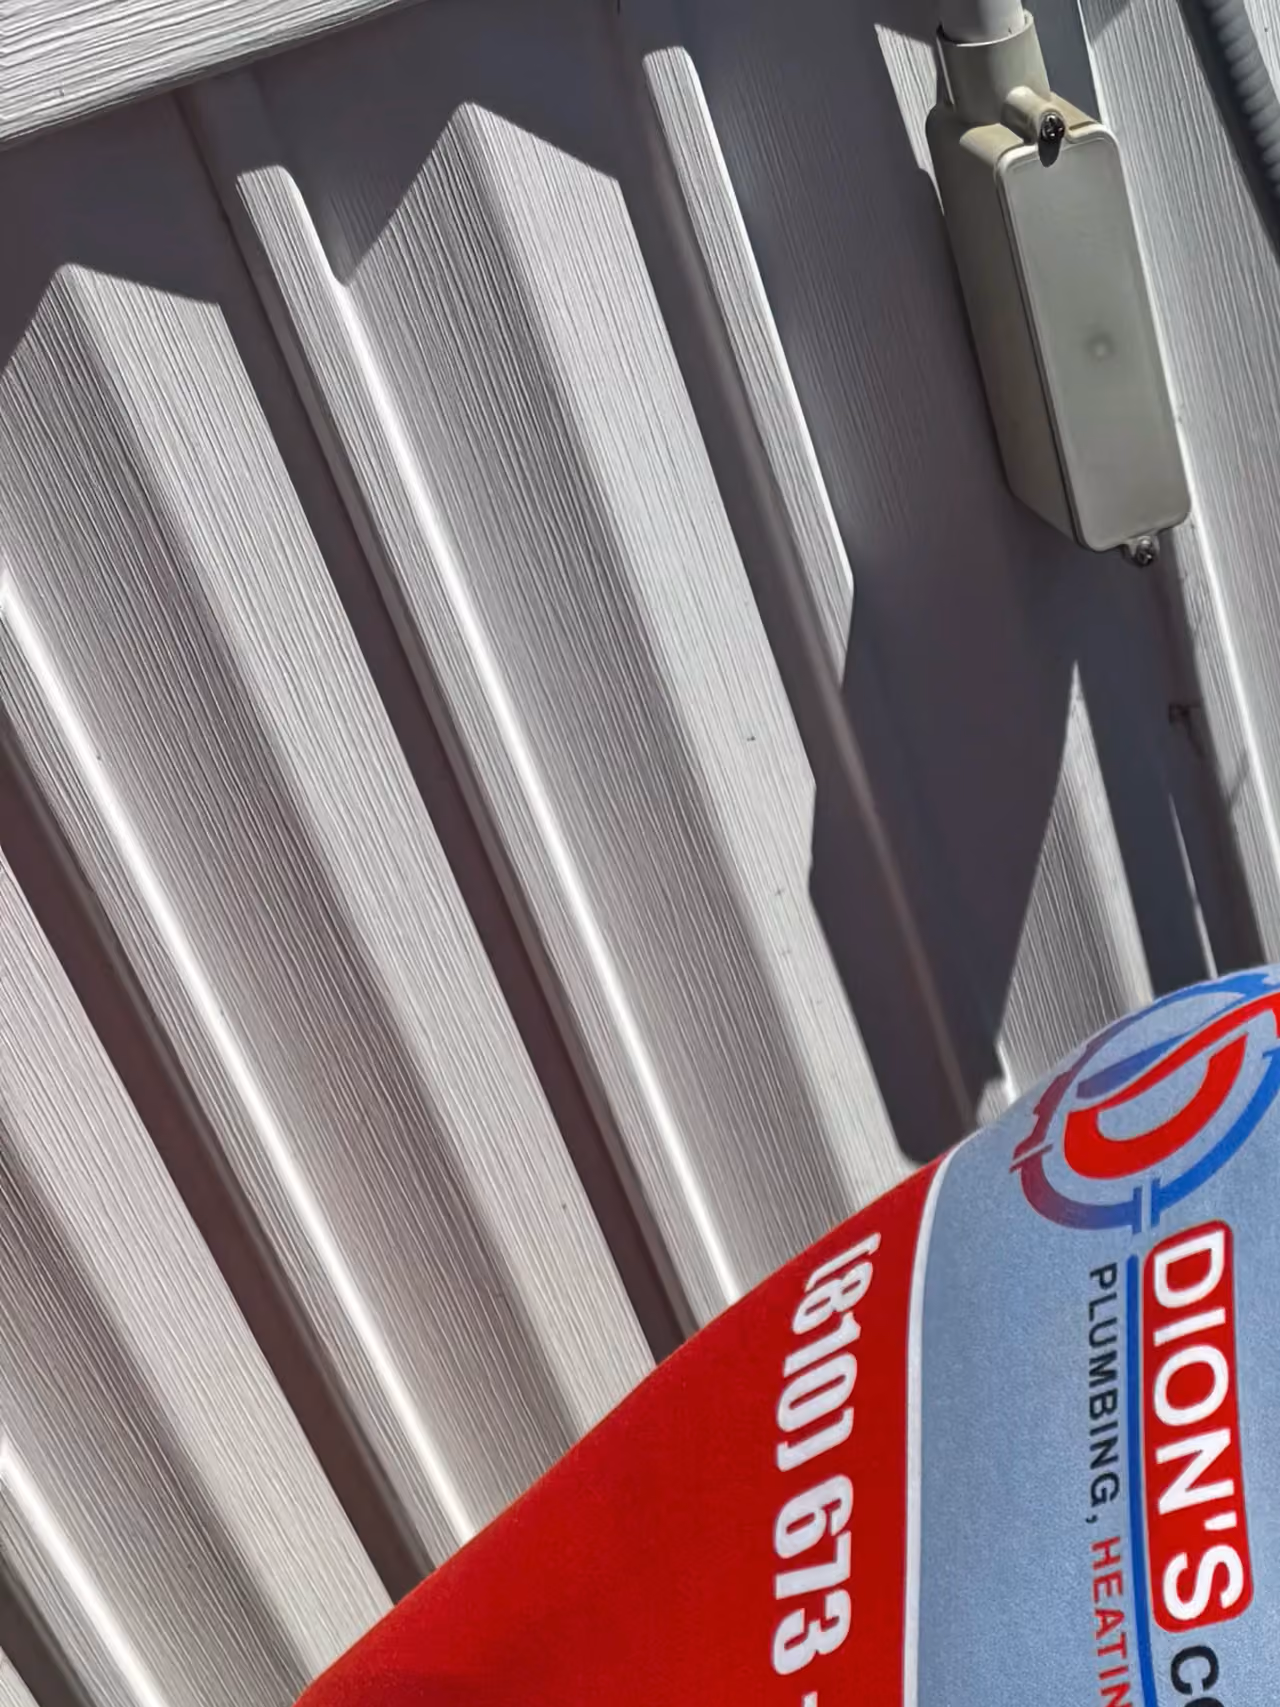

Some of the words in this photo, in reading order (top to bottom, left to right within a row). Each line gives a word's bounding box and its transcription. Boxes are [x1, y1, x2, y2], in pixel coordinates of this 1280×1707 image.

[1085, 1261, 1121, 1524] PLUMBING,
[1153, 1229, 1244, 1622] DION'S
[772, 1473, 854, 1676] 673
